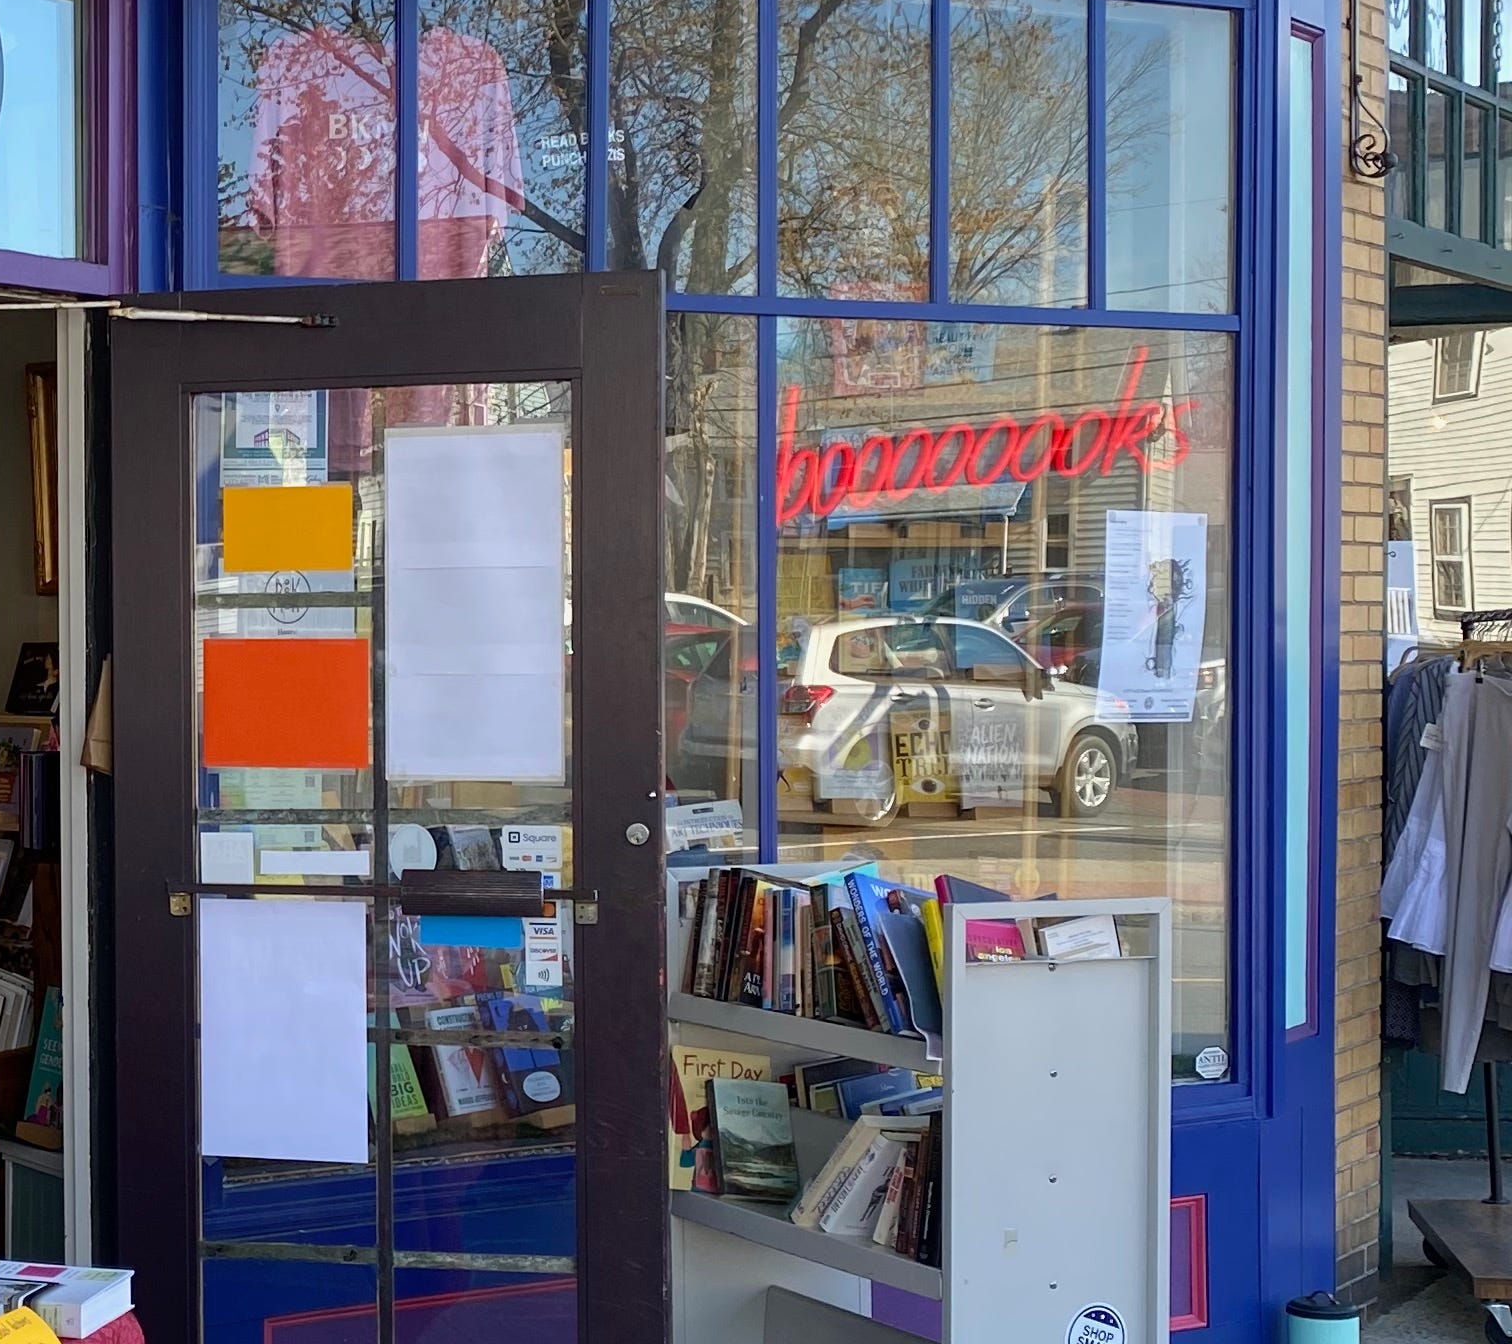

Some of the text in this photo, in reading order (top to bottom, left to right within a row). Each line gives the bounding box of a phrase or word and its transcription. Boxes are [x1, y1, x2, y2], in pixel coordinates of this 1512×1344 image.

[522, 832, 558, 844] Square
[533, 926, 555, 936] VISA
[847, 877, 889, 996] WONDERS OF THE WORLD
[683, 1054, 763, 1081] First Day
[1082, 1324, 1115, 1344] SHOP
